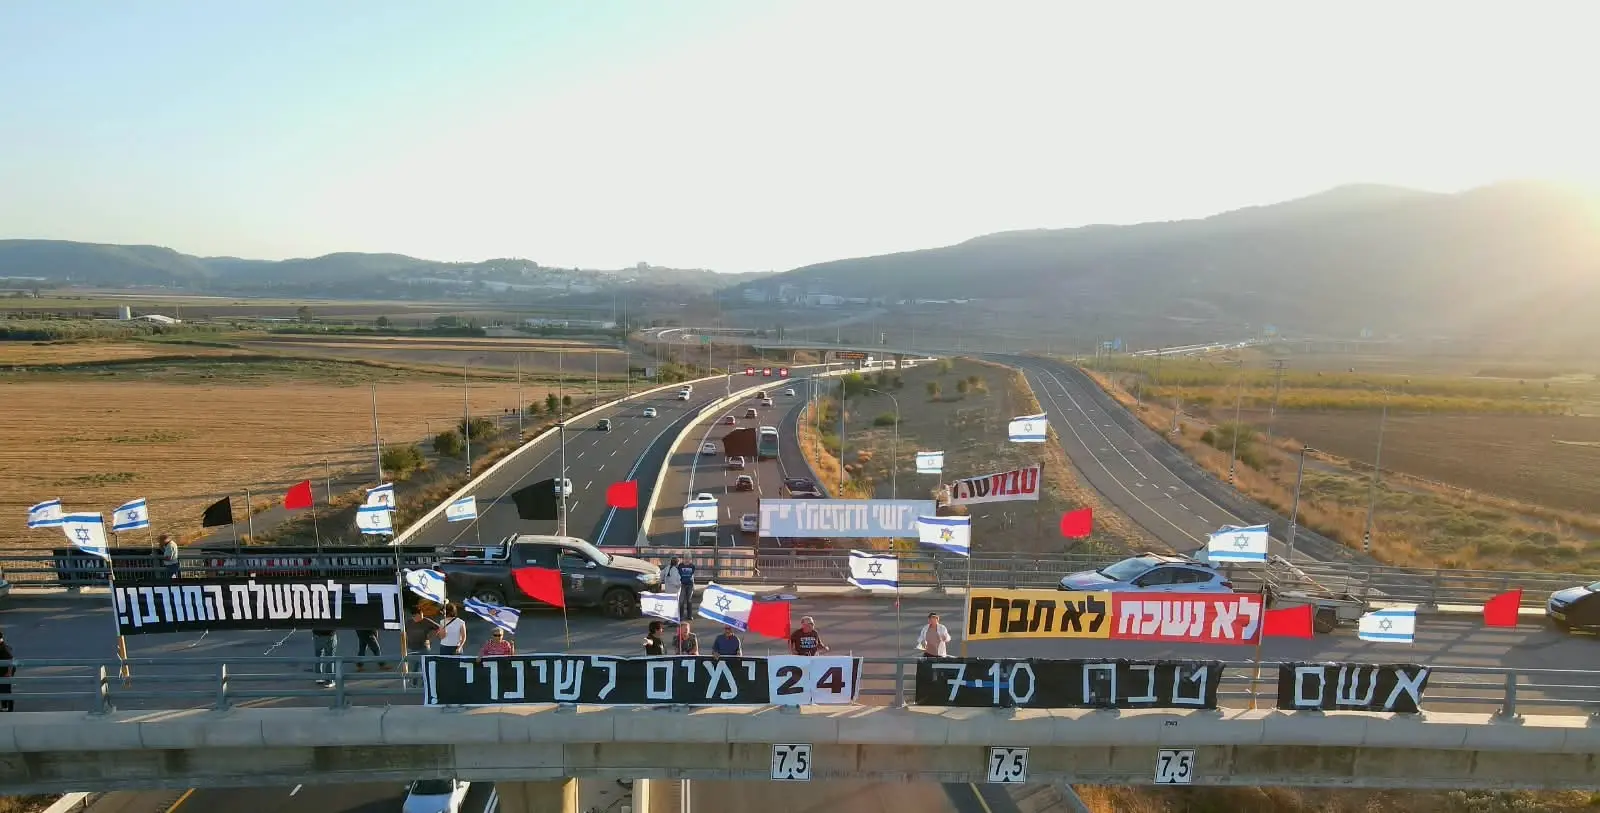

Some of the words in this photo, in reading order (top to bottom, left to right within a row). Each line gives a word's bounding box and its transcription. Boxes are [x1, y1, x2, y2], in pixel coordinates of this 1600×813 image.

[116, 585, 227, 627] החורבן!
[229, 580, 343, 620] לממשלת
[349, 583, 401, 630] די
[969, 596, 1056, 635] תברח
[1060, 595, 1106, 633] לא
[1118, 600, 1205, 637] נשכח
[1210, 597, 1261, 640] לא
[646, 659, 756, 700] ימים
[776, 664, 846, 696] 24
[1083, 663, 1208, 705] טבח
[1294, 666, 1429, 709] אשם
[776, 750, 808, 773] 7.5
[994, 754, 1023, 776] 7.5
[1160, 756, 1189, 777] 7.5
